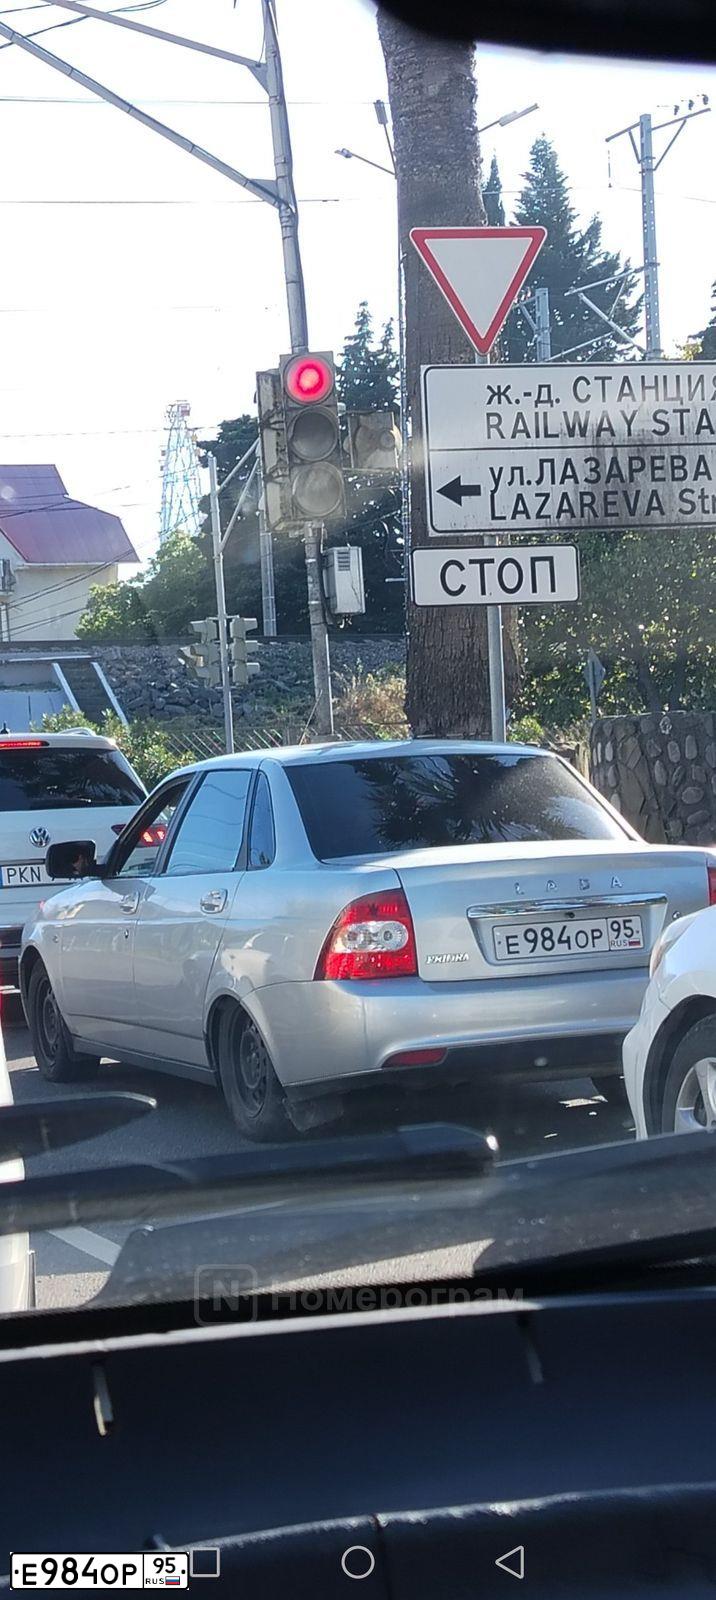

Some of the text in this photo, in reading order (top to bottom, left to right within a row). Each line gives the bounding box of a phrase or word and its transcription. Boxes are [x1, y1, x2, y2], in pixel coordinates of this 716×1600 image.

[486, 384, 560, 407] ж.-д.
[486, 408, 716, 440] RAILWAY STA
[489, 488, 666, 521] LAZAREVA
[440, 556, 557, 597] СТОП
[6, 866, 41, 884] PKN
[514, 876, 624, 895] LADA
[505, 919, 634, 955] Е984ОР 95
[610, 940, 628, 948] RUS
